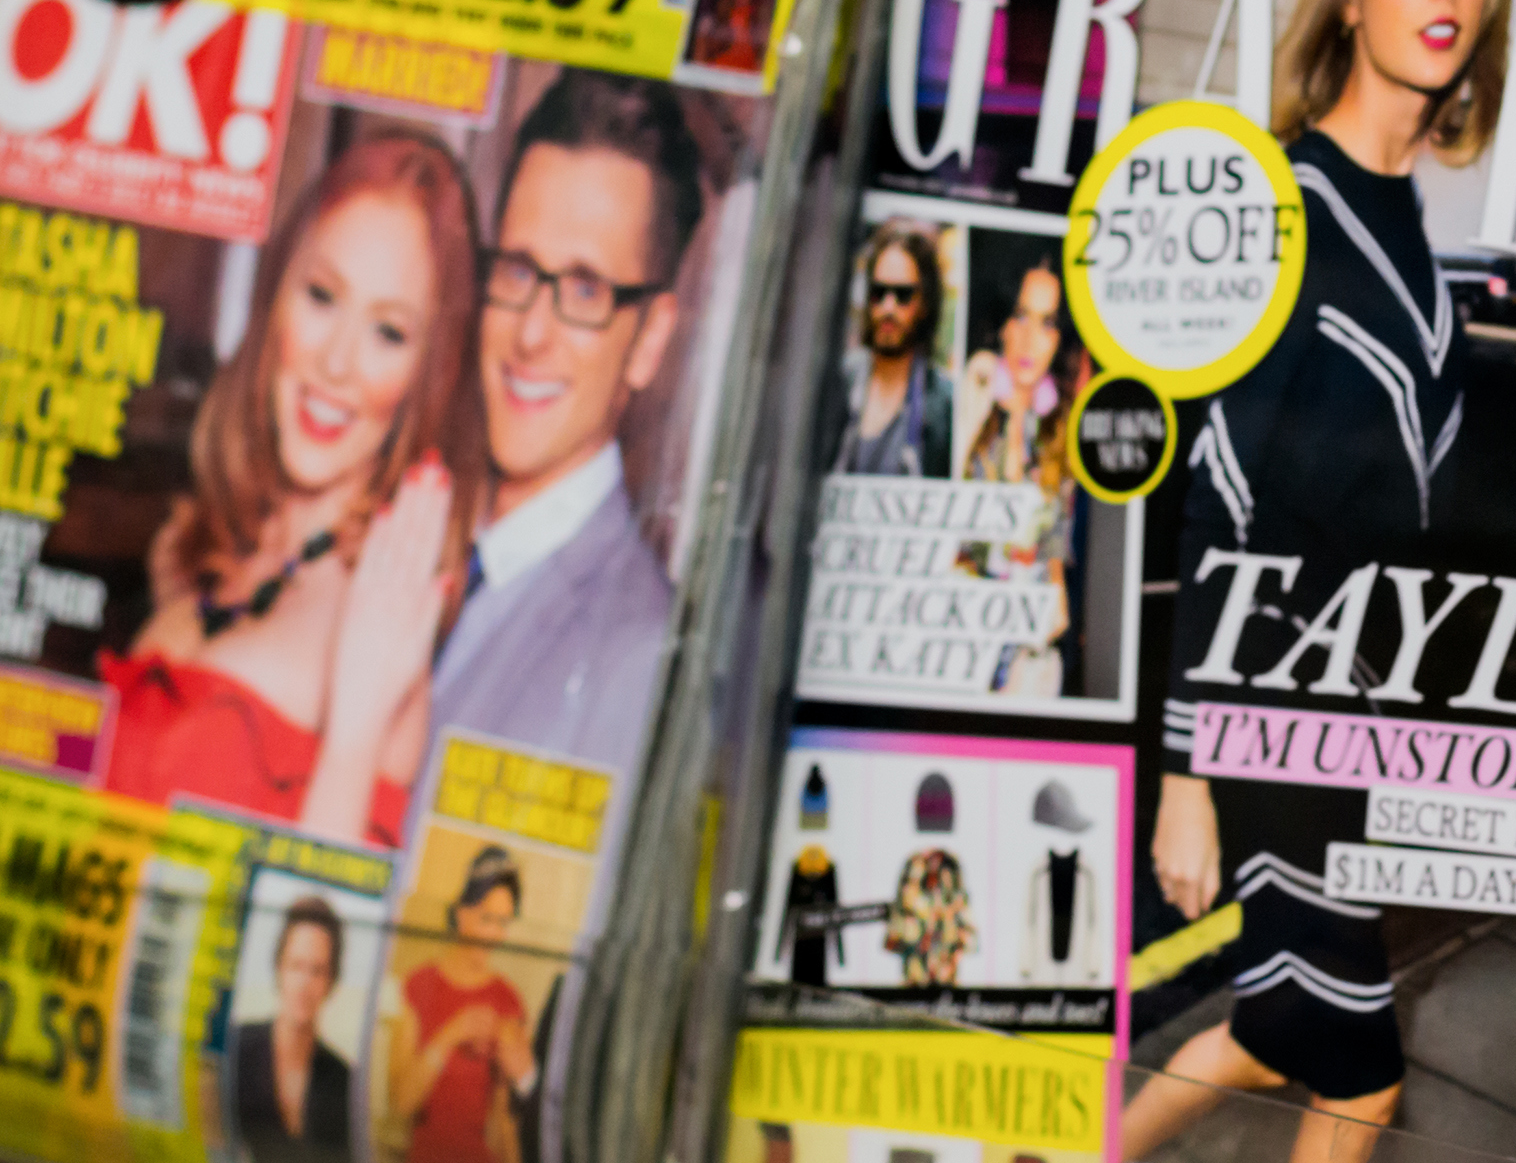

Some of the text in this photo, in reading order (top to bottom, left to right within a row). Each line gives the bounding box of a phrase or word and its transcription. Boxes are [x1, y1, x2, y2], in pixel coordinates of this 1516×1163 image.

[1127, 155, 1246, 198] PLUS
[1073, 203, 1300, 273] 25% OFF
[1104, 274, 1264, 306] RIVER ISLAND
[814, 584, 1049, 634] ATTACK ON
[805, 629, 990, 682] EX KATY
[1201, 708, 1304, 770] 'I'M
[1374, 796, 1504, 845] SECRET
[1331, 852, 1405, 901] $1M
[1413, 862, 1442, 899] A
[736, 1039, 1092, 1141] WINTER WARMERS
